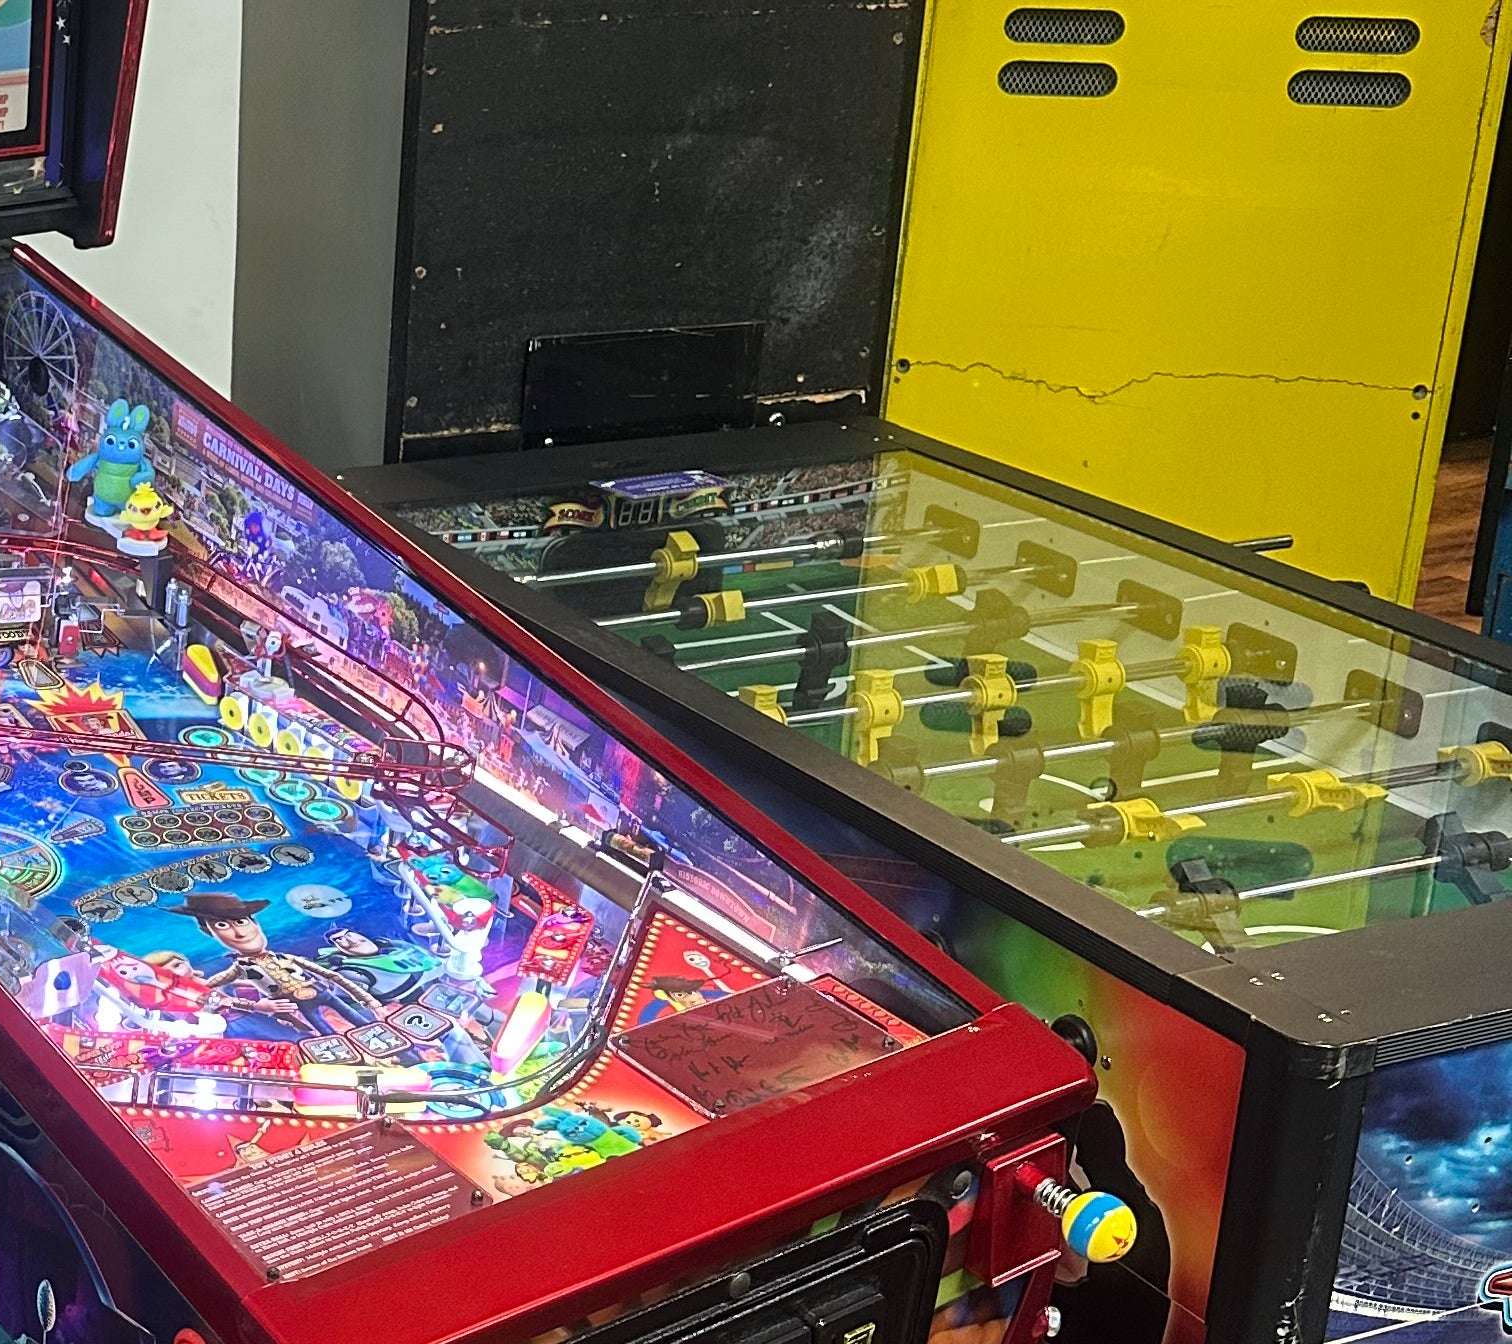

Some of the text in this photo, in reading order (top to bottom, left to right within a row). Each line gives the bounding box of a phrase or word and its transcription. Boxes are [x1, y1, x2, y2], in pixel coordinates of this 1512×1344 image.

[202, 431, 295, 501] CARNIVAL DAYS
[186, 792, 248, 801] TICKETS
